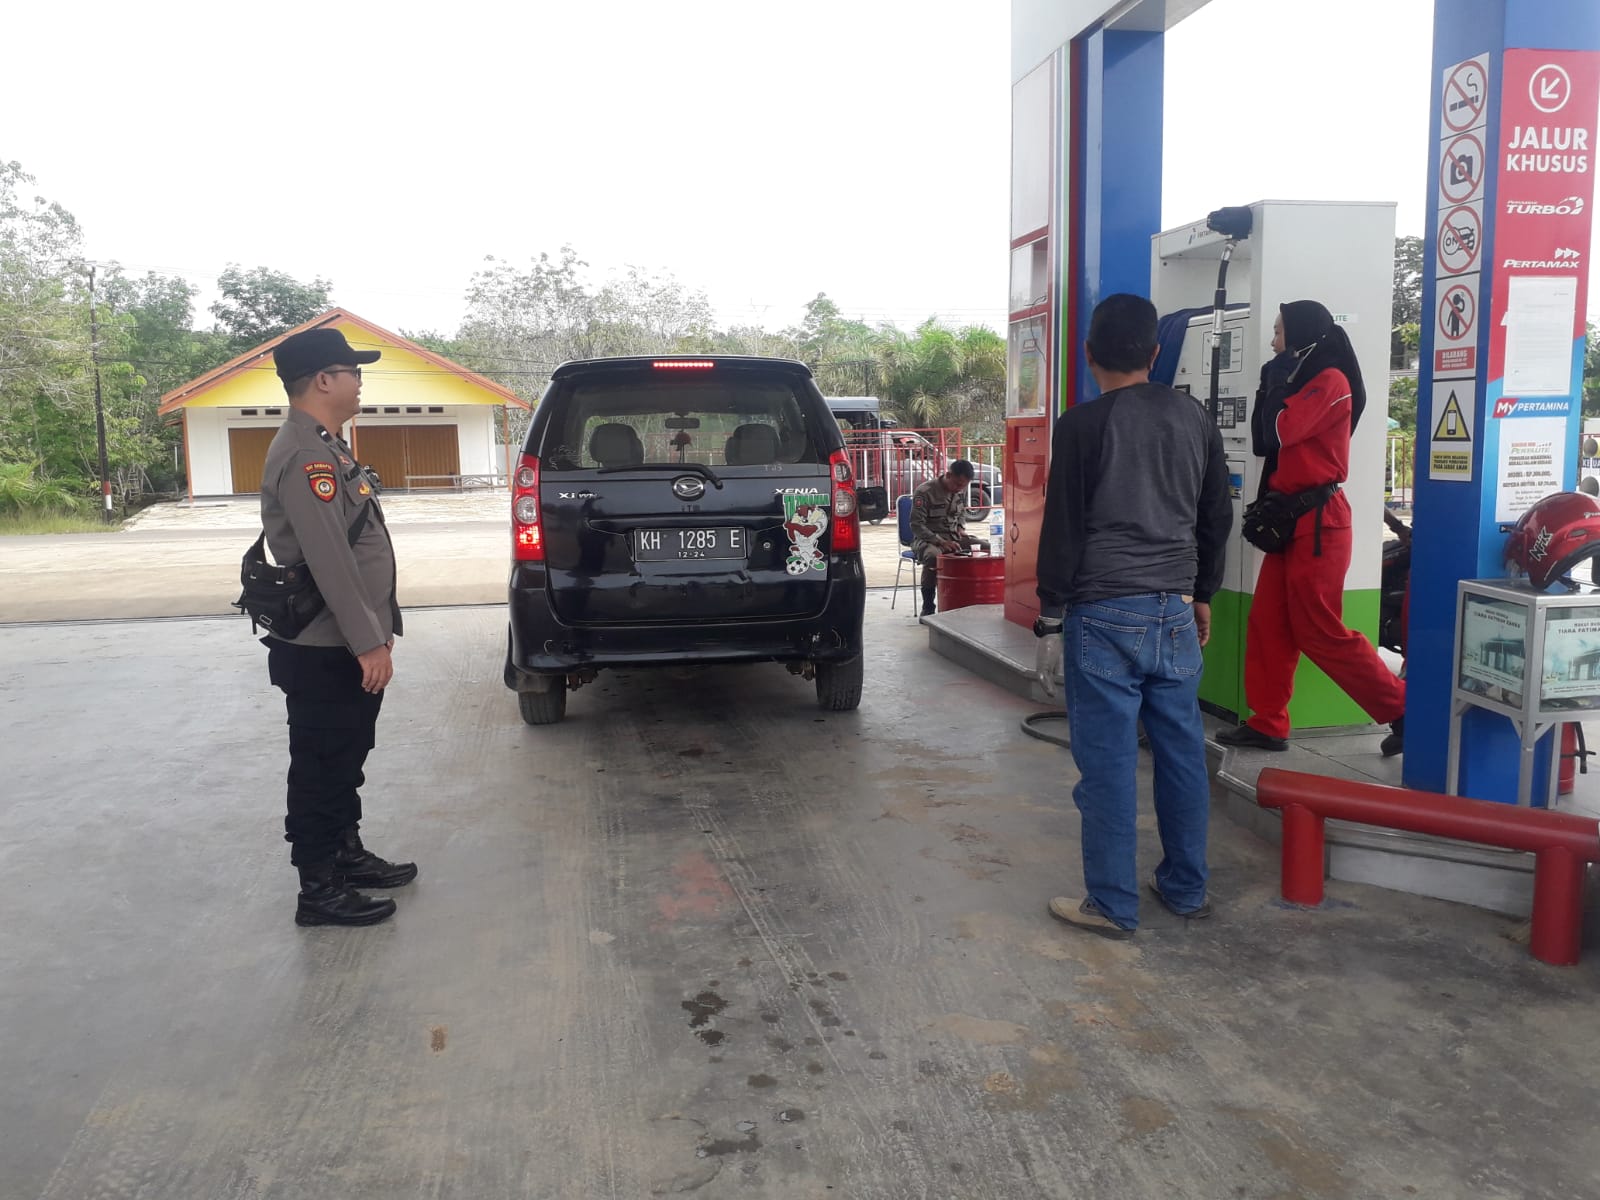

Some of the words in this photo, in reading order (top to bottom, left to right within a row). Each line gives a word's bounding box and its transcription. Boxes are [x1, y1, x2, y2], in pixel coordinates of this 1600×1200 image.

[1508, 126, 1588, 150] JALUR
[1506, 154, 1588, 173] KHUSUS
[1506, 204, 1570, 215] TURBO
[1503, 258, 1579, 268] PERTAMAX
[640, 531, 660, 550] KH
[679, 530, 716, 549] 1285
[730, 529, 740, 548] E
